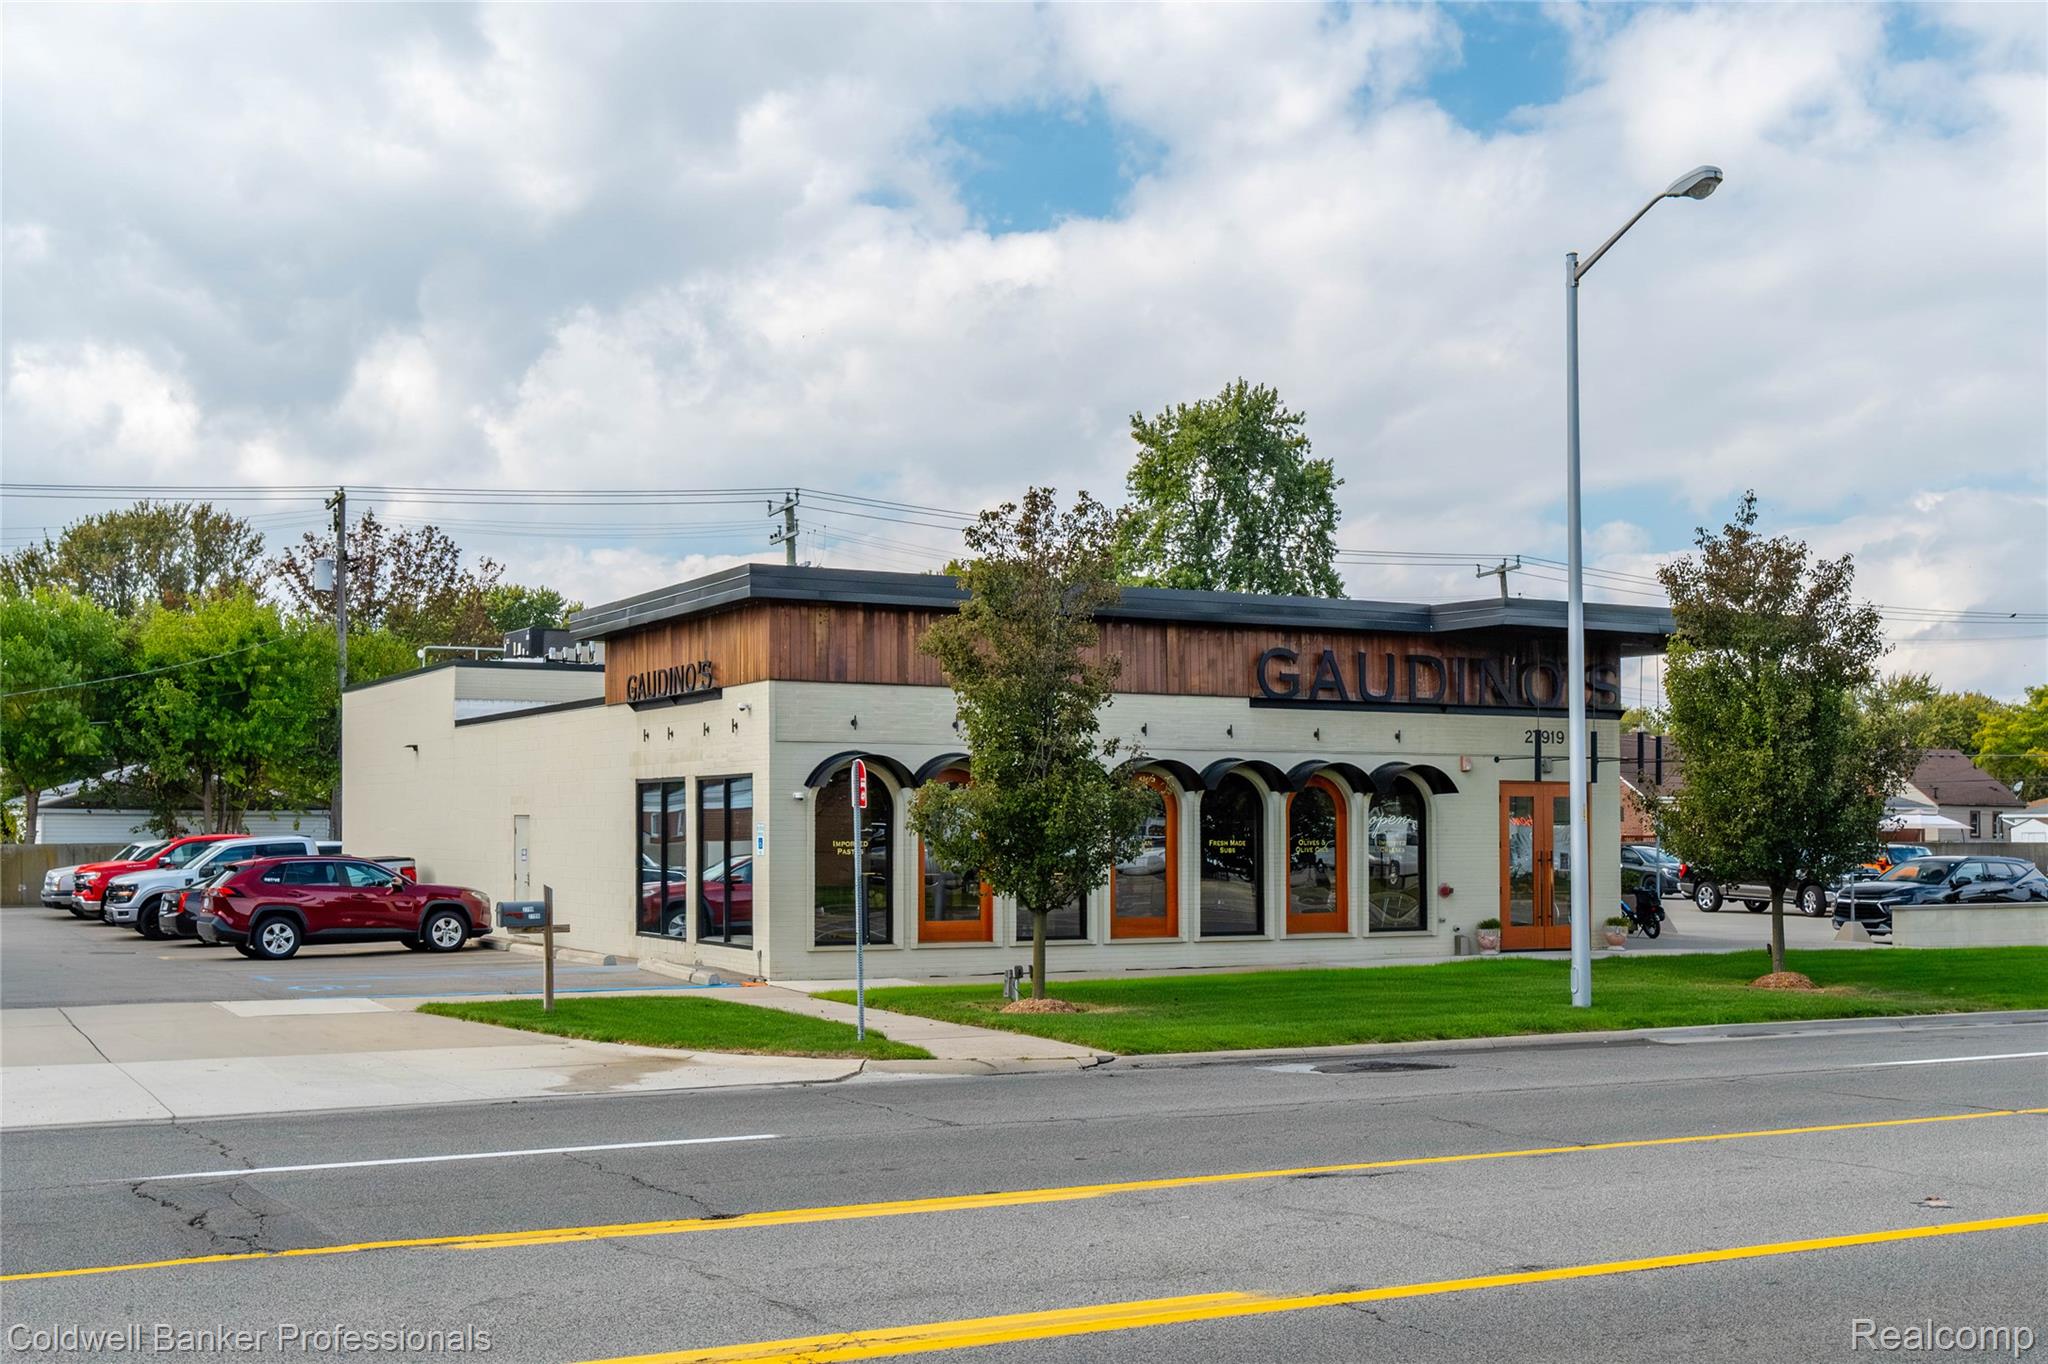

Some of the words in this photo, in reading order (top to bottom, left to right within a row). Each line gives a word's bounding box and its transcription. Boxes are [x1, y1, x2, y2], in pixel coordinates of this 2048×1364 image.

[627, 660, 713, 701] GAUDINO'S
[1257, 647, 1619, 707] GAUDINOS
[836, 847, 864, 855] PASTS
